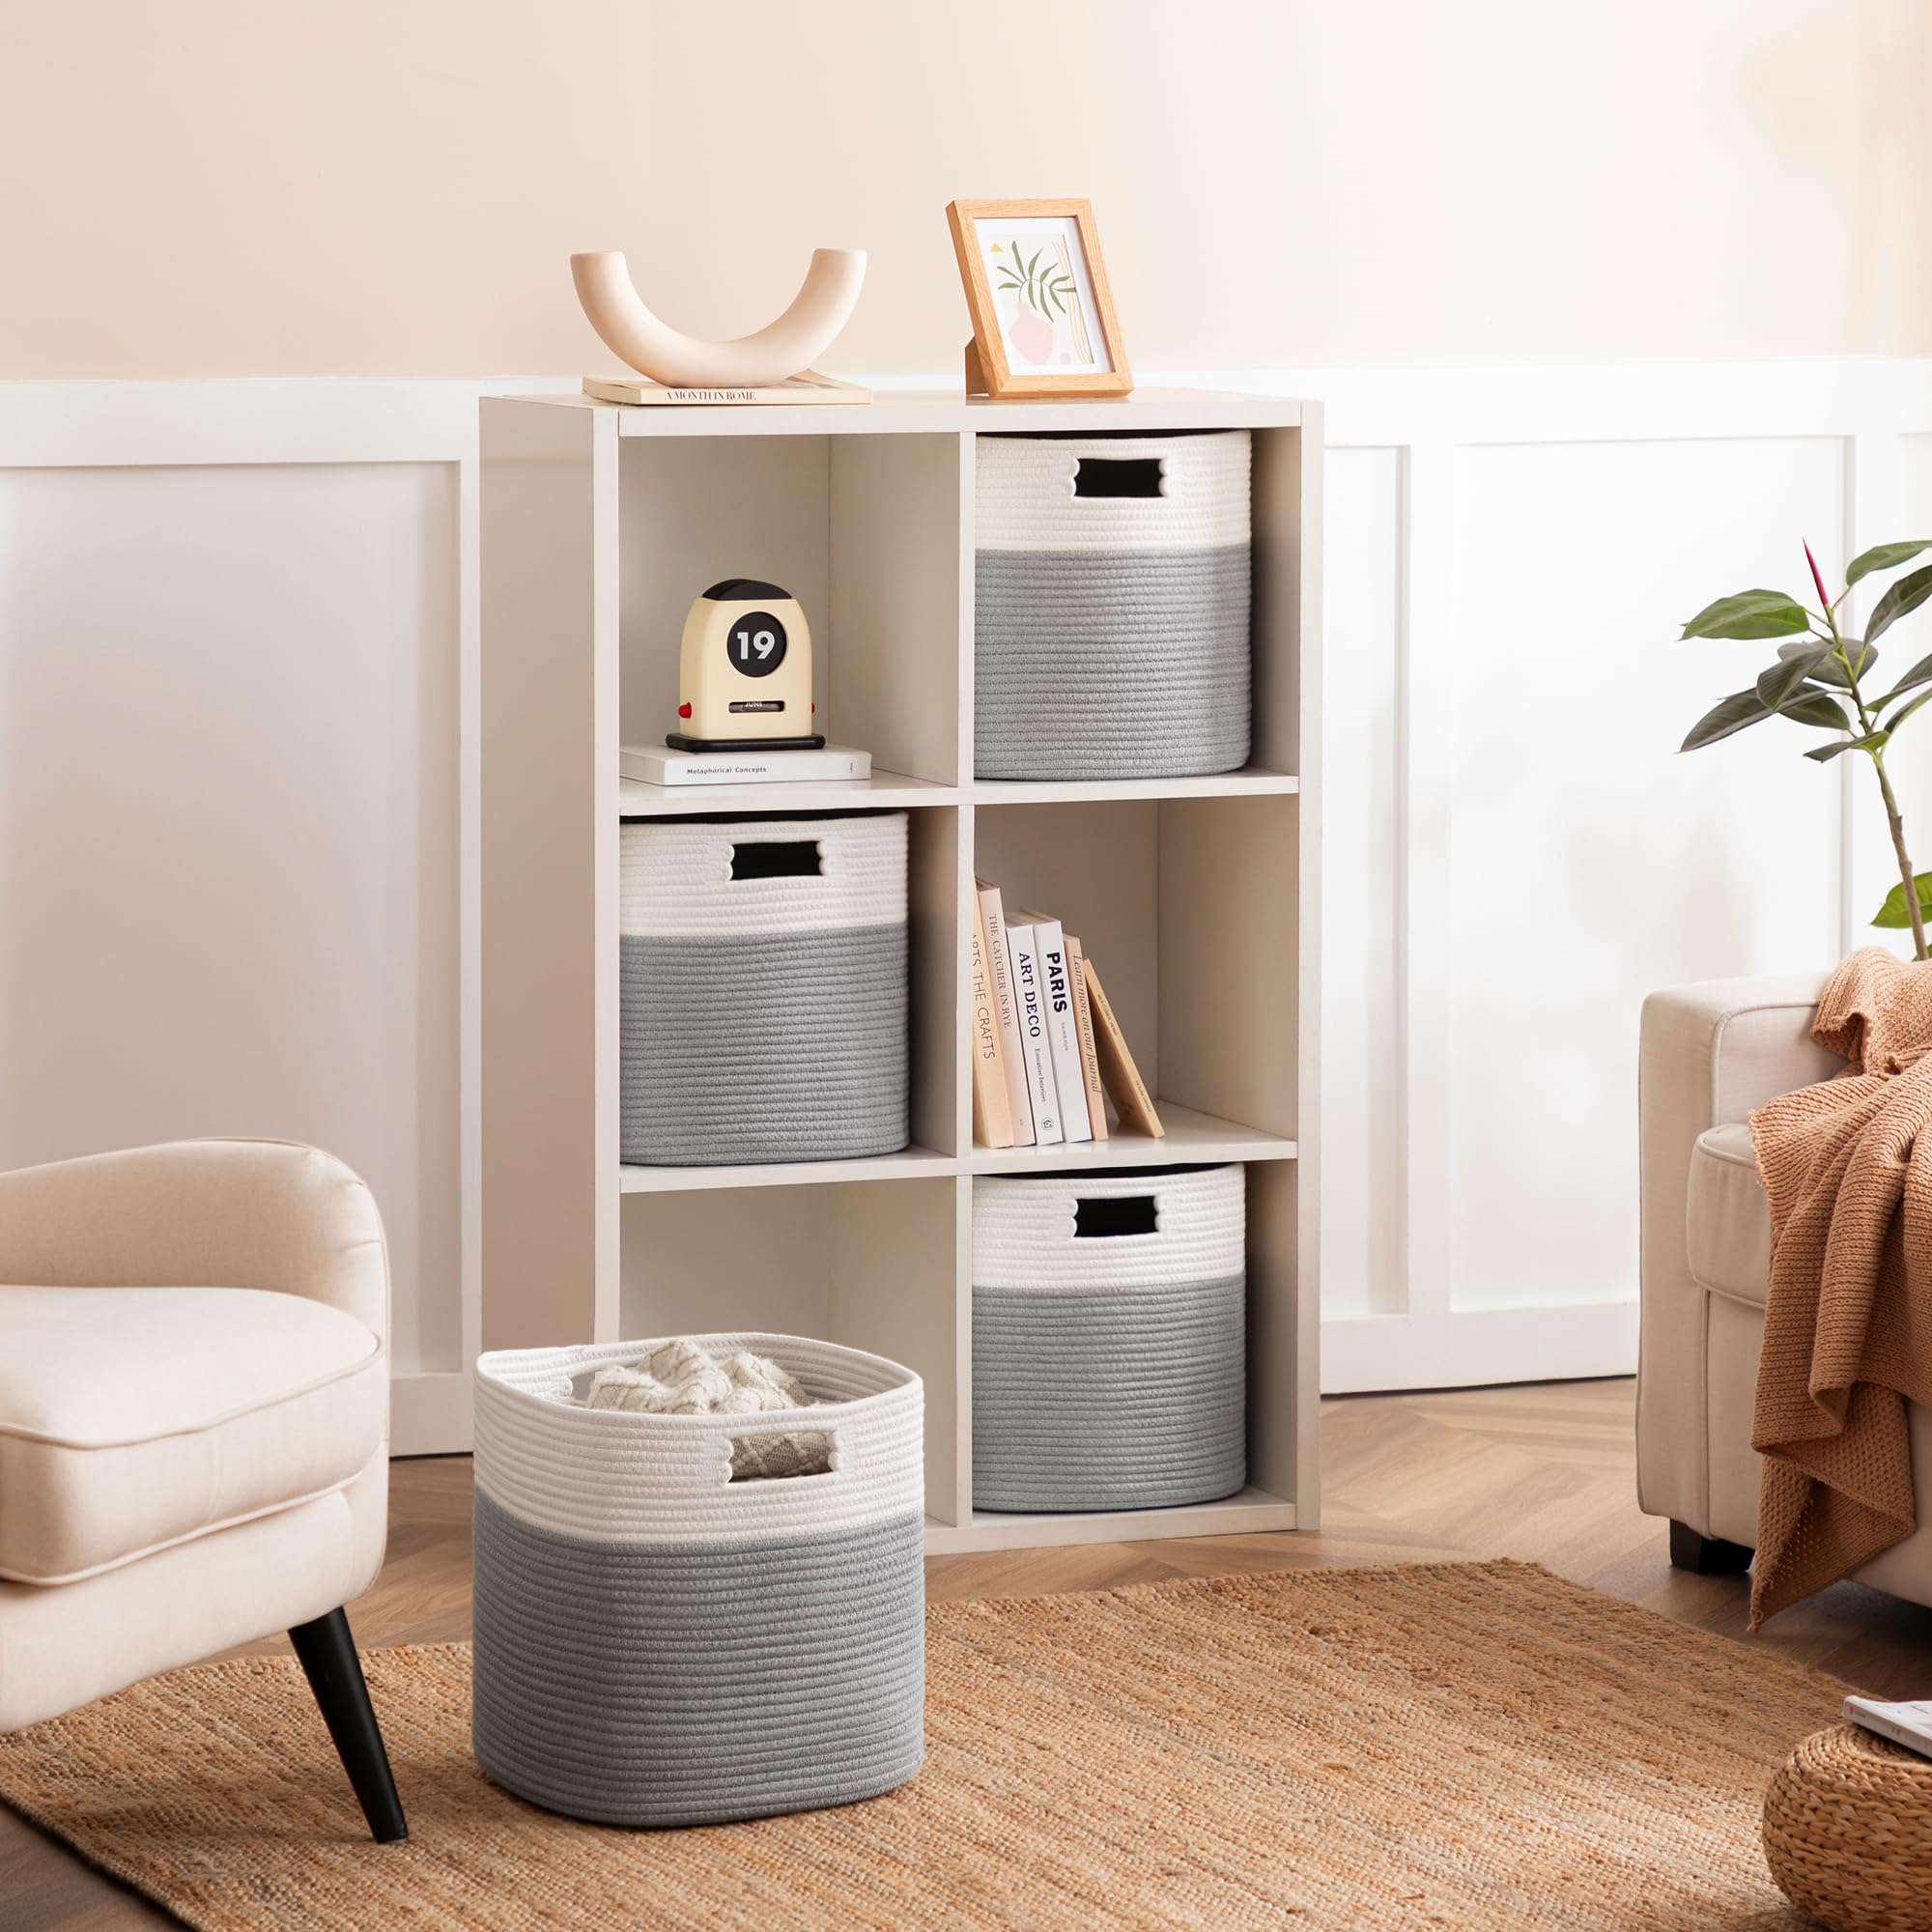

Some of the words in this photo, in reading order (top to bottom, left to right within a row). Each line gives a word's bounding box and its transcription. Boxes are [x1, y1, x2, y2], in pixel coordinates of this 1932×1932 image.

[674, 391, 711, 400] MONTH
[714, 391, 724, 400] IN
[725, 391, 756, 401] ROME
[737, 630, 776, 660] 19
[735, 766, 767, 775] Concepts
[989, 914, 999, 936] THE
[973, 934, 981, 967] RTS
[992, 940, 1007, 989] CATCHER
[1019, 952, 1034, 986] ART
[1046, 952, 1067, 1013] PARIS
[1073, 954, 1082, 986] Learn
[973, 972, 987, 1002] THE
[1000, 994, 1009, 1005] IN
[1078, 987, 1089, 1017] more
[1002, 1008, 1012, 1029] RYE
[1024, 990, 1041, 1037] DECO
[1082, 1016, 1090, 1034] on
[977, 1007, 996, 1060] CRAFTS
[1084, 1032, 1094, 1053] our
